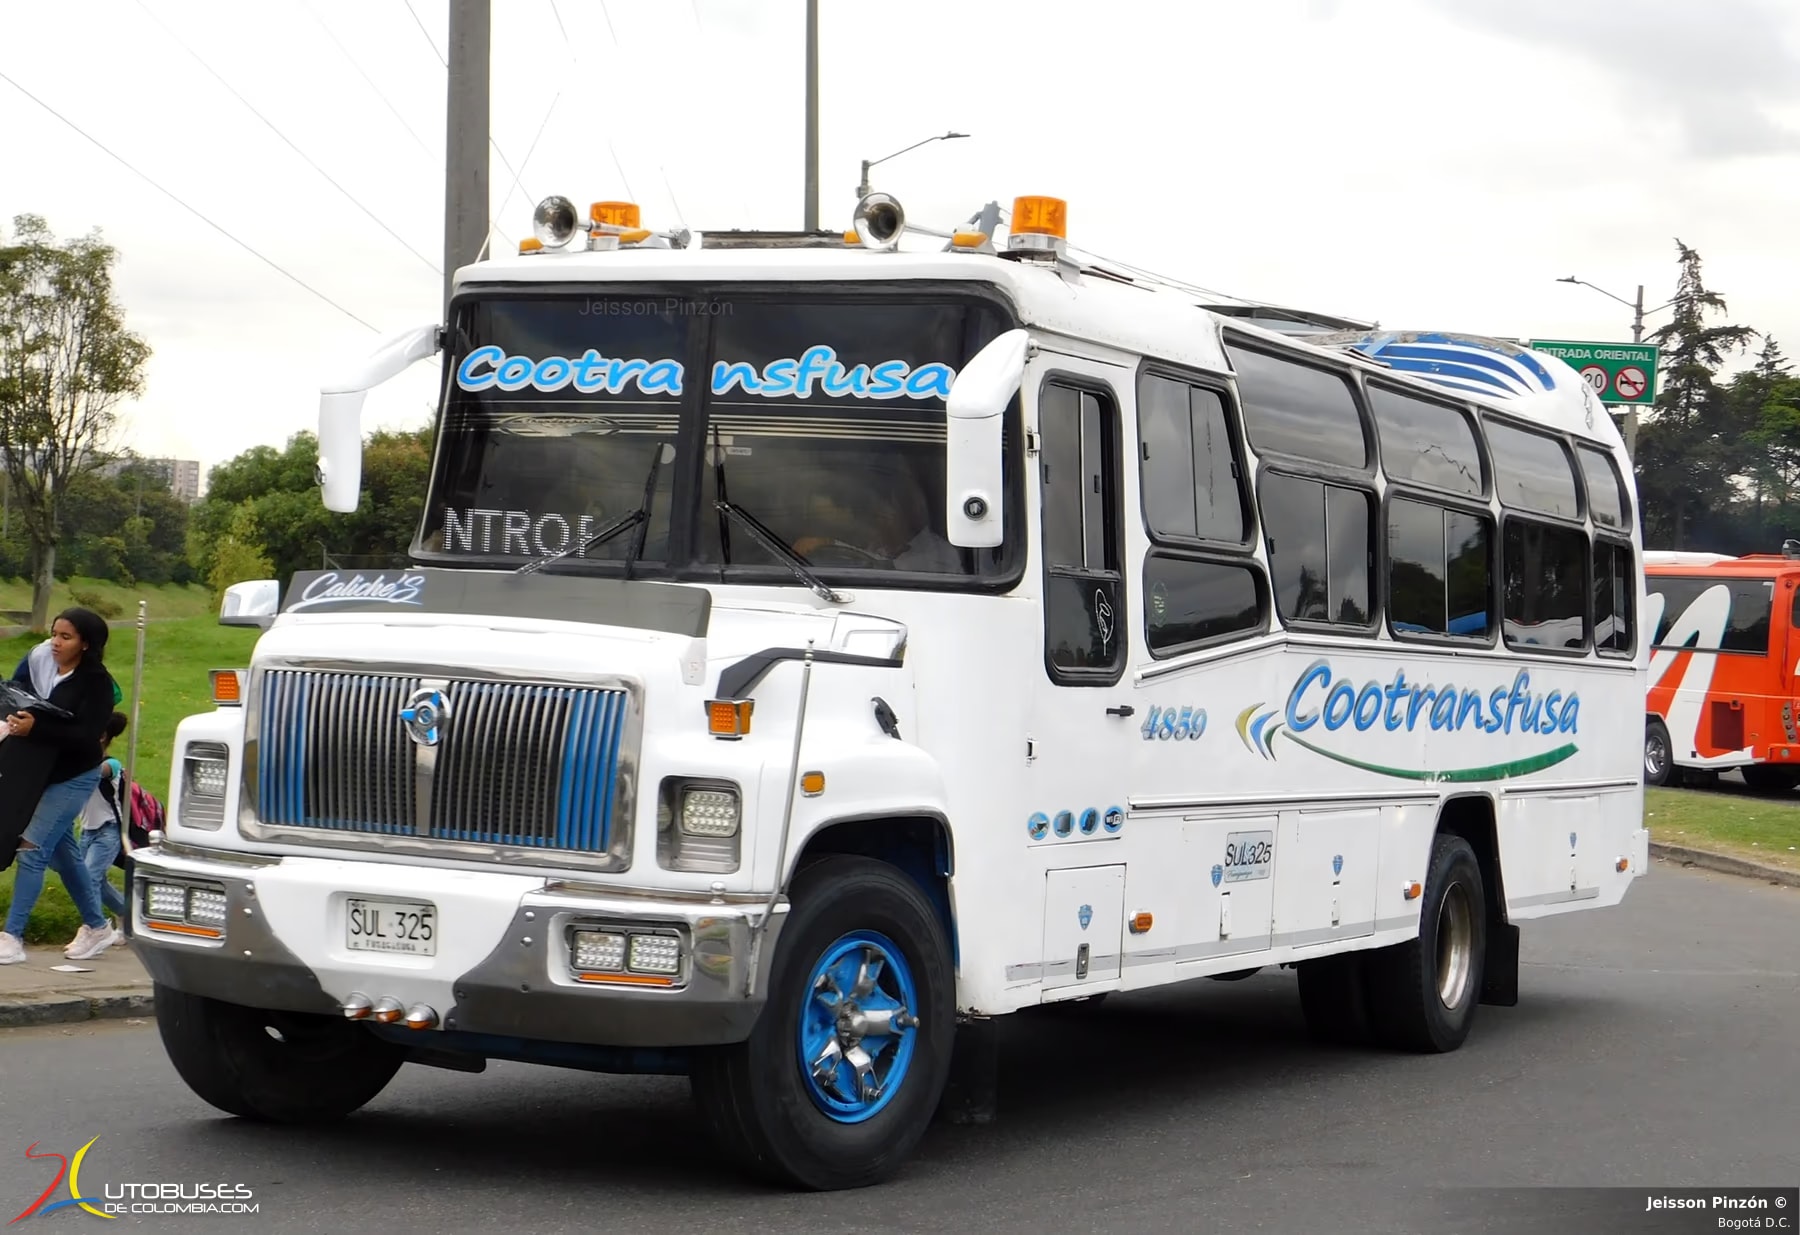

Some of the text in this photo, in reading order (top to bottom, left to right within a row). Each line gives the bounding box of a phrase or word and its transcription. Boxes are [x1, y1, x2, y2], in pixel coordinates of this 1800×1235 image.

[457, 345, 954, 399] Cootra nsfusa
[1594, 349, 1652, 362] ORIENTAL
[1285, 658, 1581, 735] Cootransfusa
[1140, 704, 1208, 741] 4859
[351, 908, 433, 941] SUL 325
